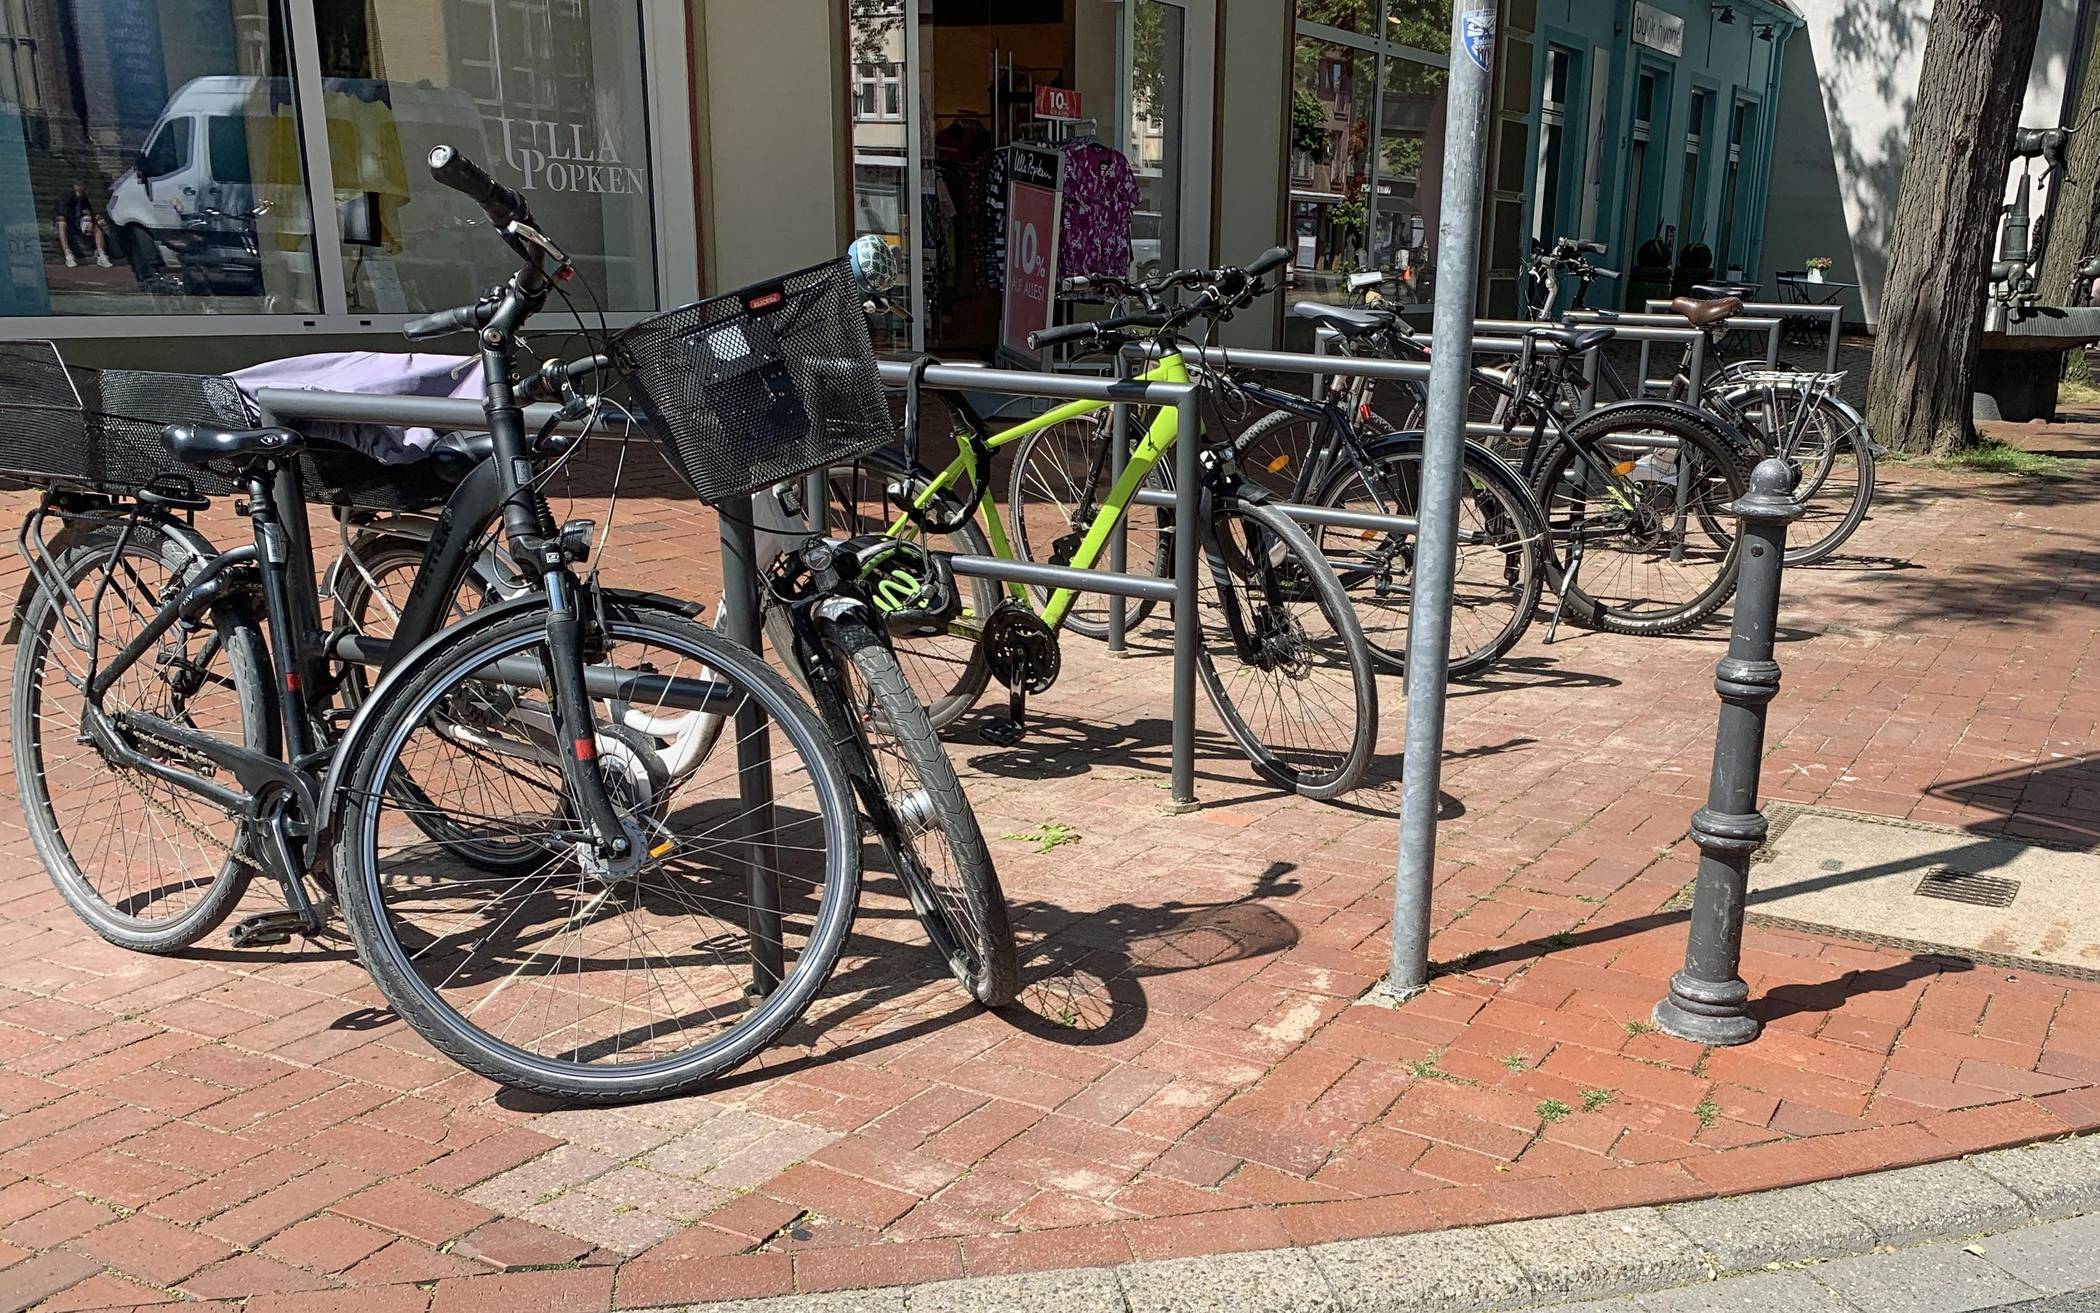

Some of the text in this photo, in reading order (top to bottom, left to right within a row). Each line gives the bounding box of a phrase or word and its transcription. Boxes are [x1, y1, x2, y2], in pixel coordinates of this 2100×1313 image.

[496, 116, 622, 172] ULLA
[518, 148, 646, 195] POPKEN
[1014, 220, 1046, 278] 10%
